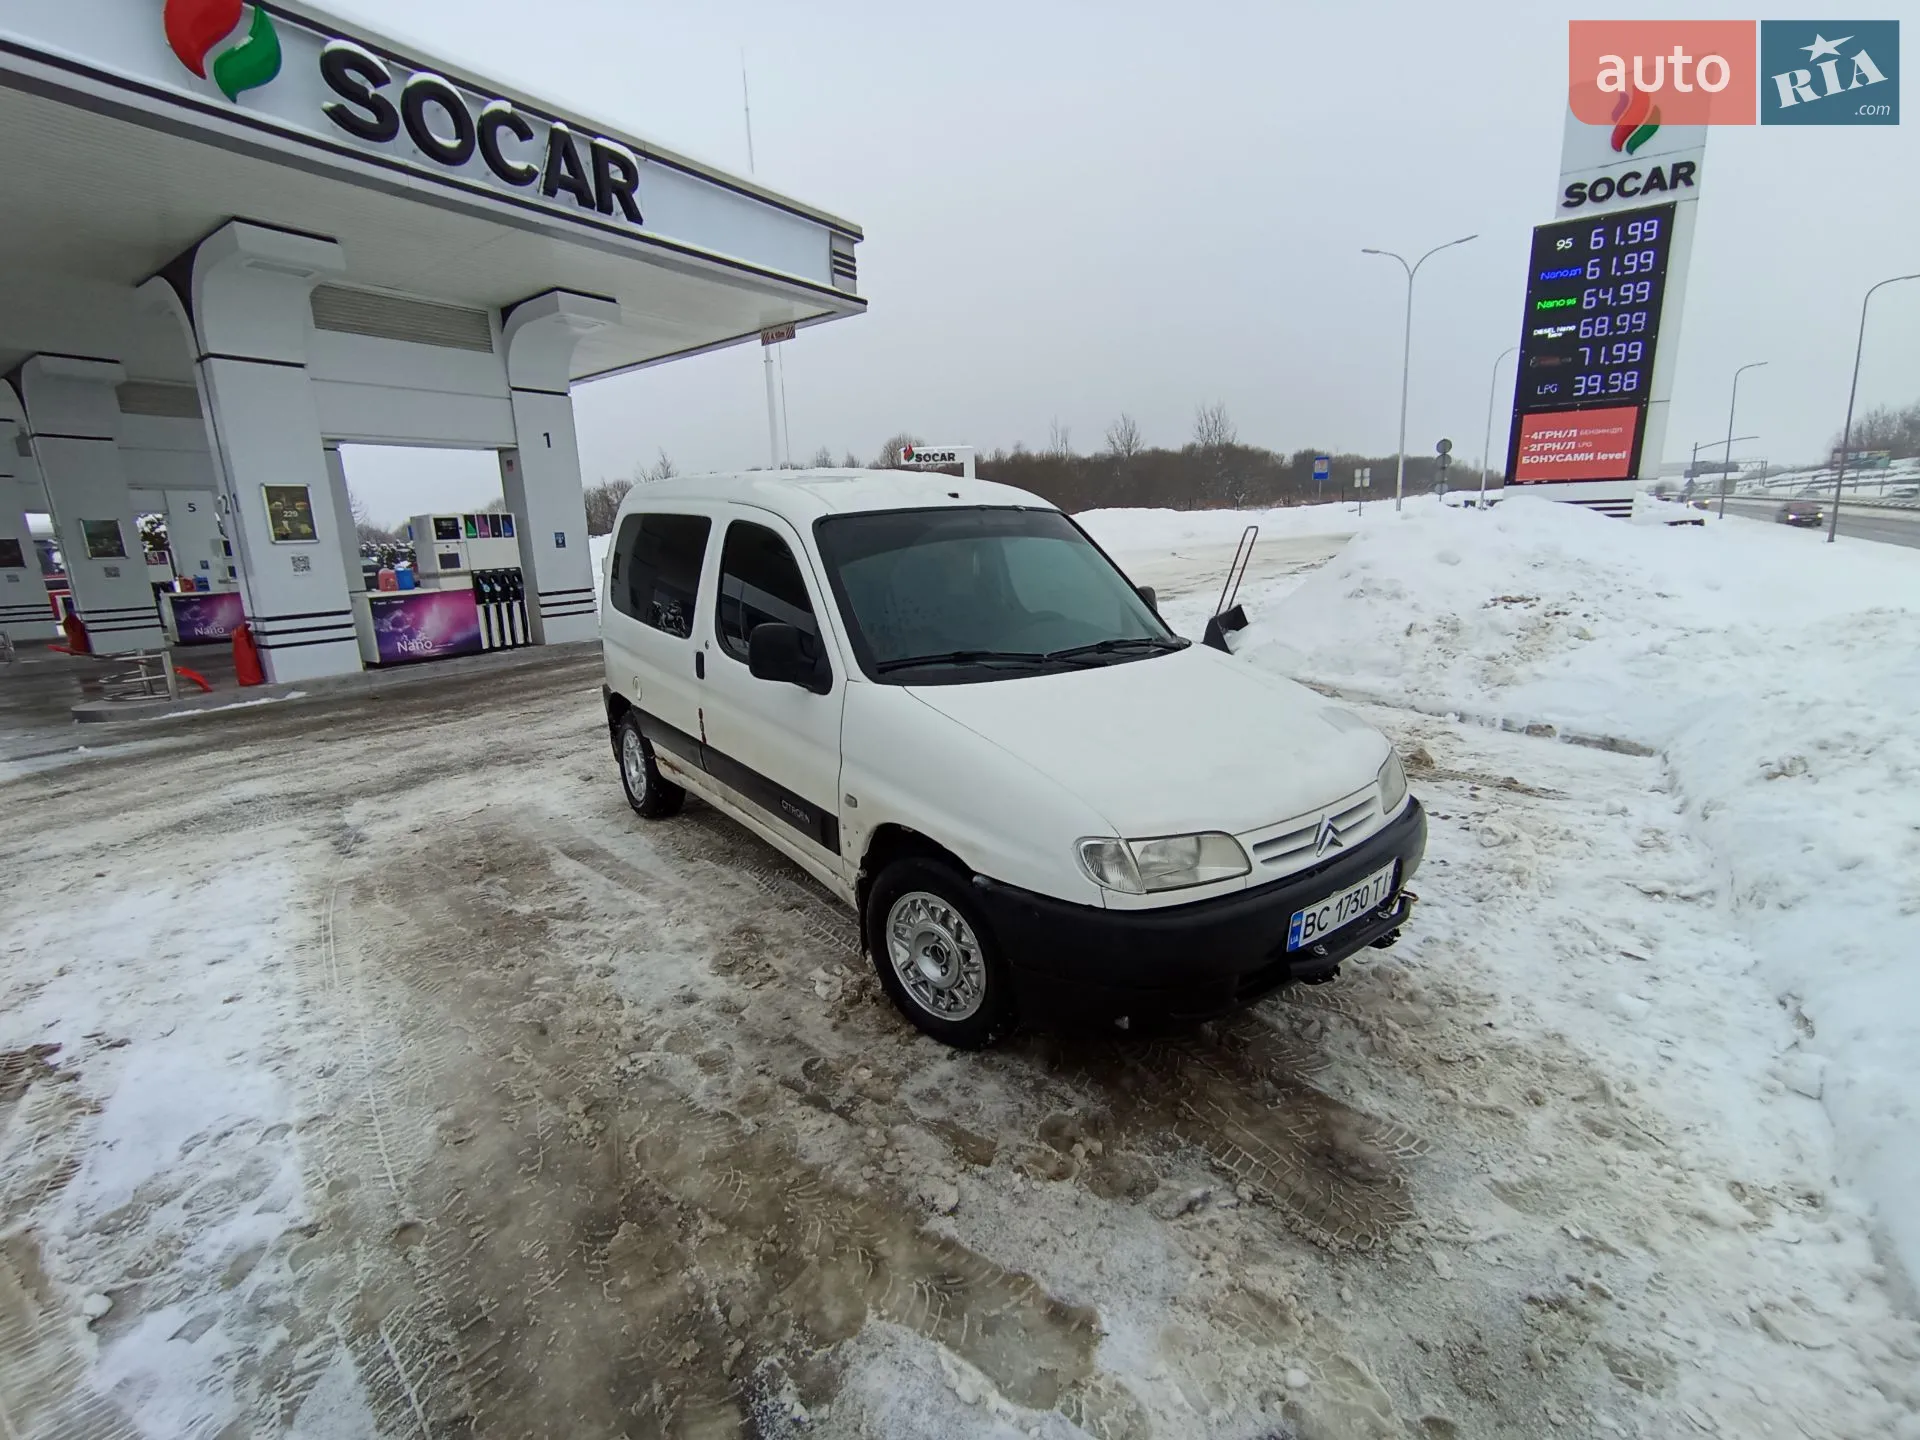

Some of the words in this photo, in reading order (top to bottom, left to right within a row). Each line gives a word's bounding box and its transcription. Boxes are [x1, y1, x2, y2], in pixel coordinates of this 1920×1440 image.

[319, 38, 643, 226] SOCAR
[1561, 160, 1696, 208] SOCAR
[1556, 237, 1573, 251] 95
[1589, 219, 1658, 250] 61.99
[1586, 250, 1654, 280] 61.99
[1582, 281, 1650, 309] 64.99
[1579, 311, 1646, 339] 68.99
[1579, 341, 1642, 366] 71.99
[1537, 384, 1558, 395] LPG
[1573, 370, 1638, 396] 39.98
[543, 432, 551, 449] 1
[915, 452, 956, 463] SOCAR
[1521, 452, 1595, 465] БОНУСАМИ
[1597, 450, 1627, 461] level
[194, 627, 225, 636] Nano
[396, 639, 433, 653] Nano
[1303, 905, 1330, 940] BC
[1336, 885, 1370, 923] 1730
[1373, 871, 1389, 901] TI
